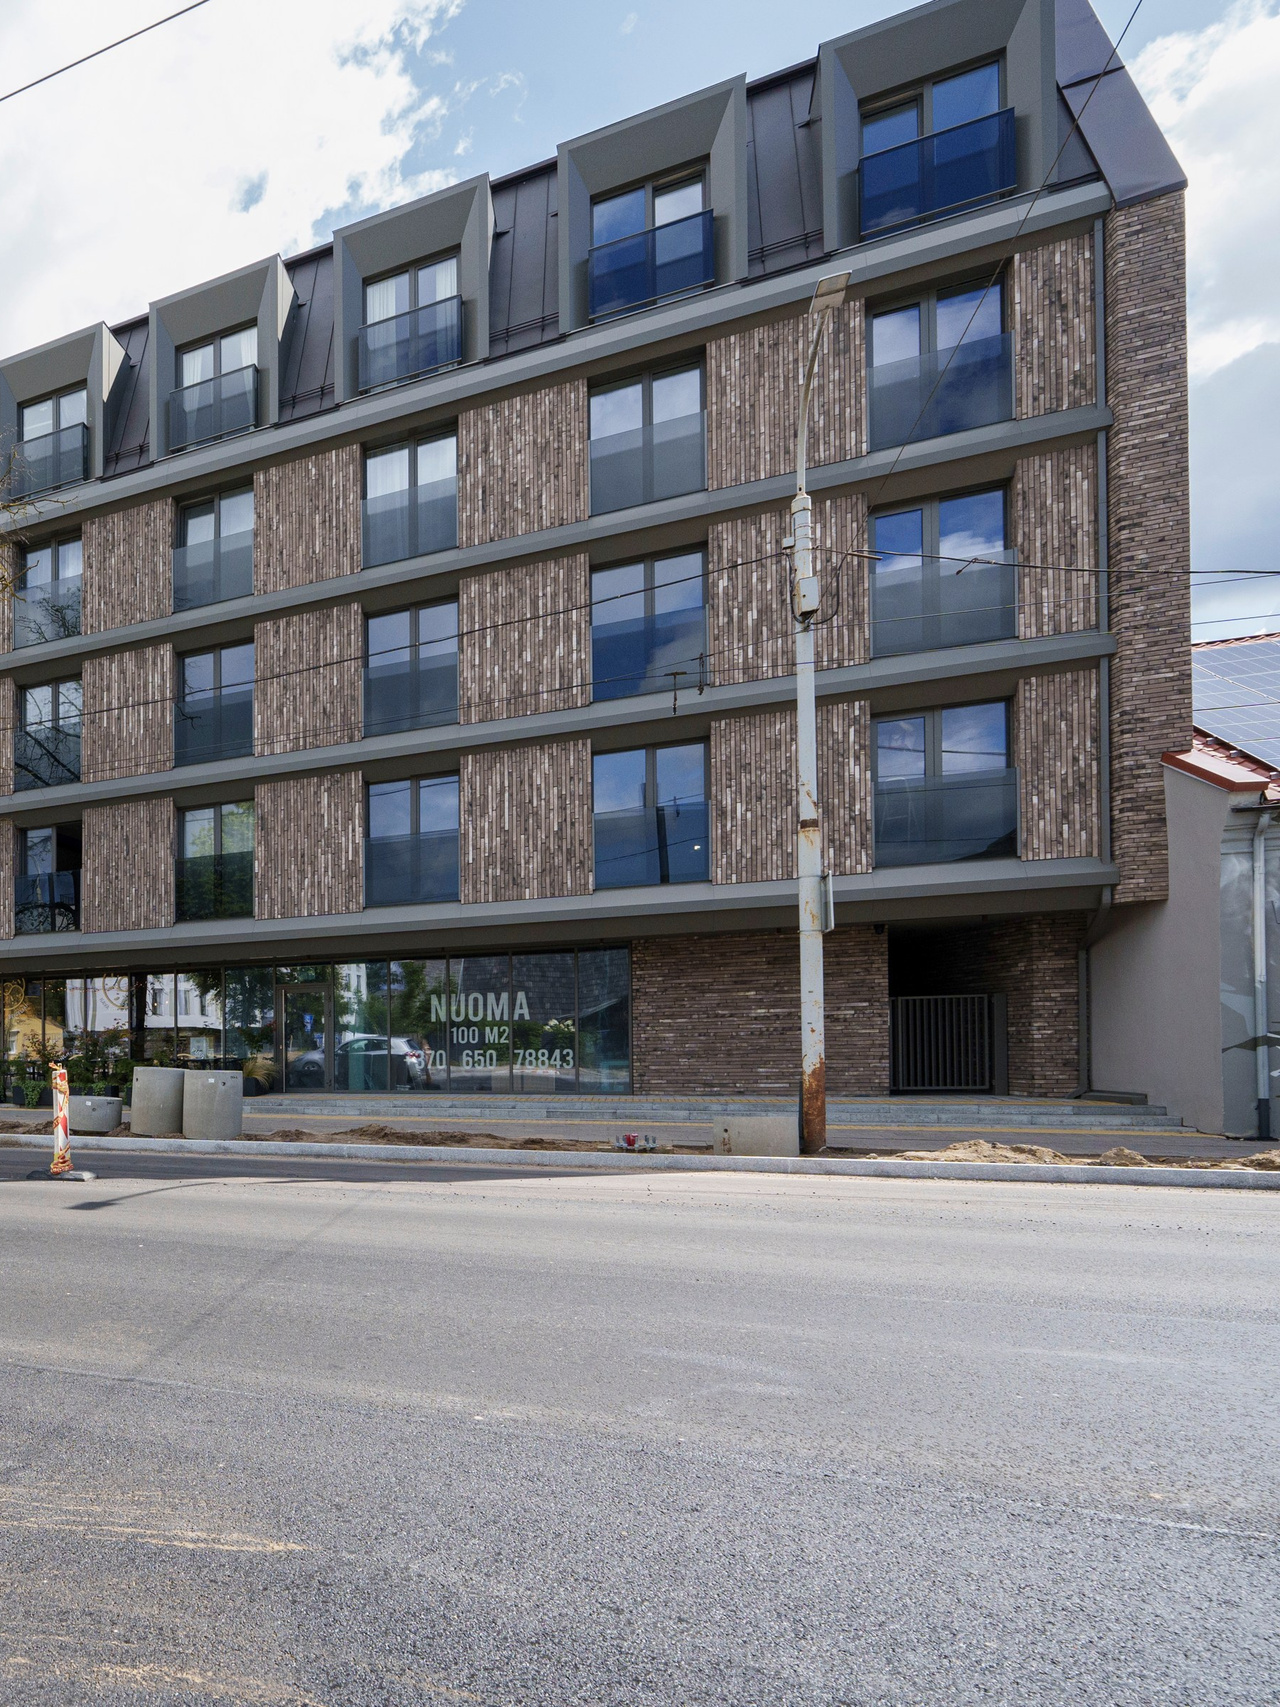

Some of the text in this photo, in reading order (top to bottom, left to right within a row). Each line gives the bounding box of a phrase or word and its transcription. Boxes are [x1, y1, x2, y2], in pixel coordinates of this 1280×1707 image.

[430, 991, 530, 1022] NUOMA
[451, 1026, 509, 1044] 100 M2
[462, 1049, 497, 1069] 650
[514, 1048, 574, 1069] 78843
